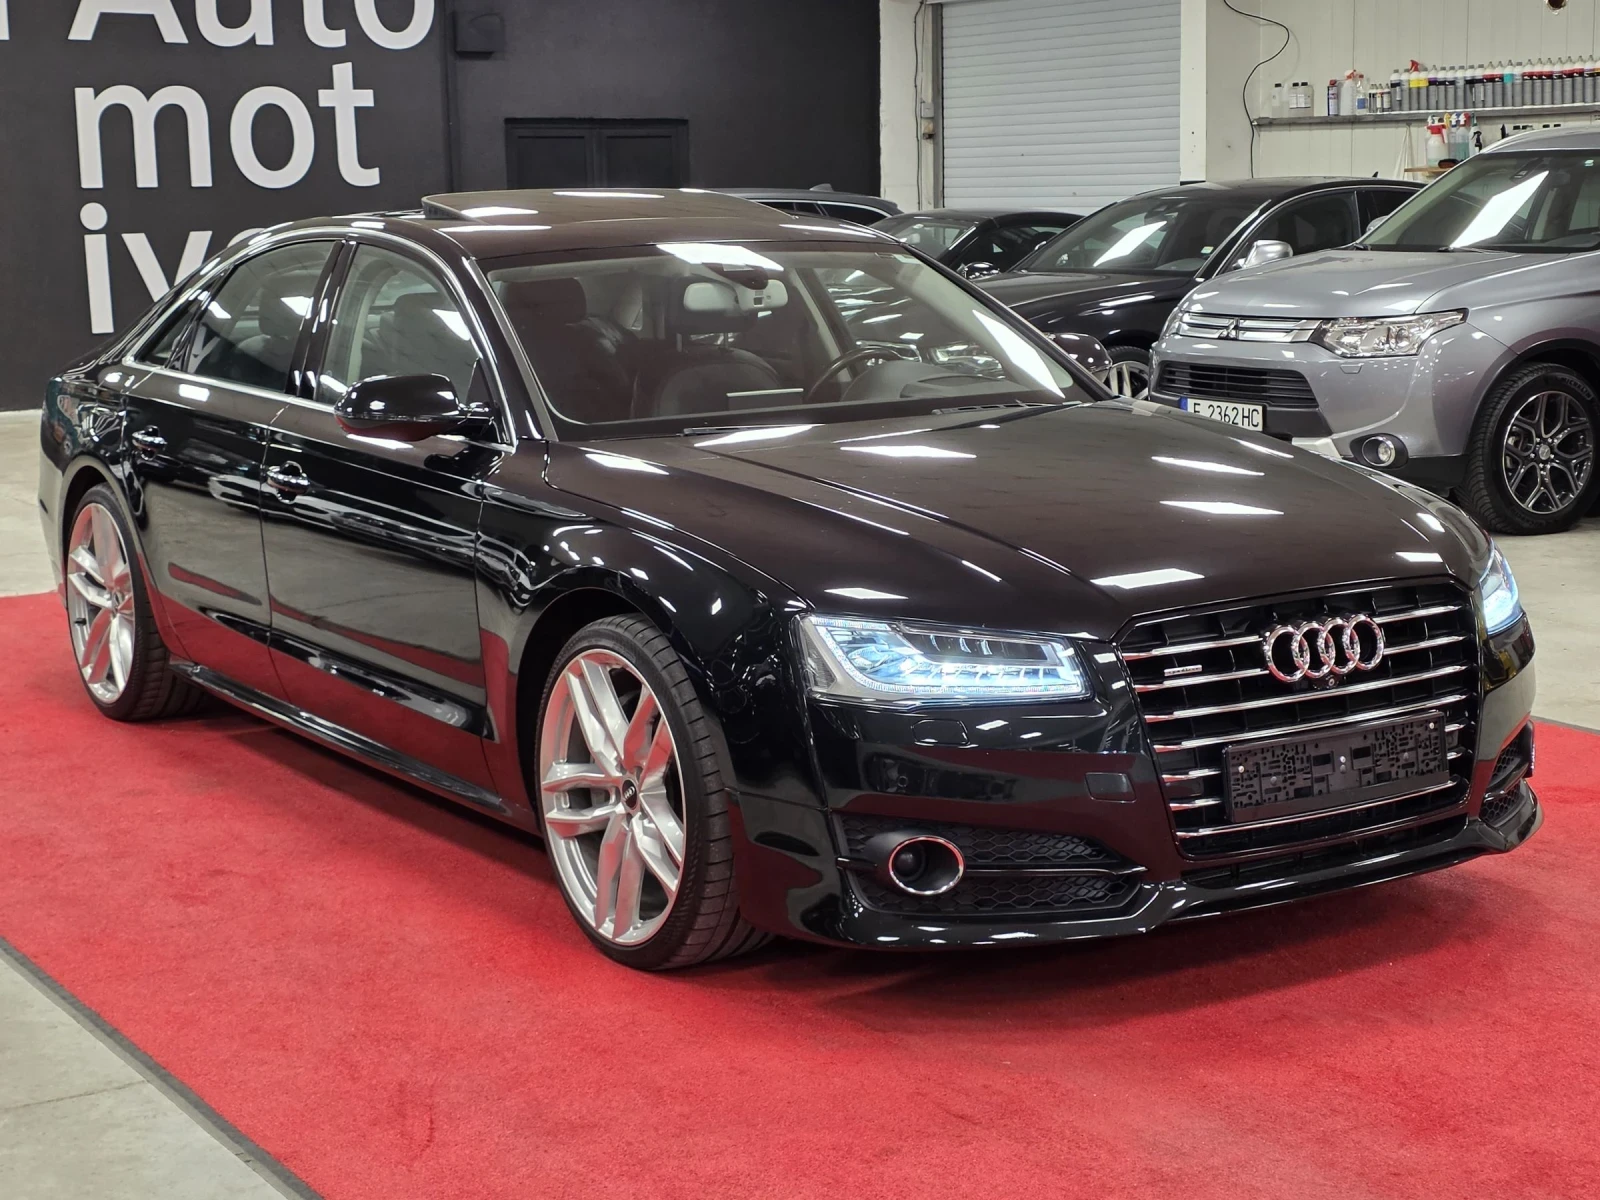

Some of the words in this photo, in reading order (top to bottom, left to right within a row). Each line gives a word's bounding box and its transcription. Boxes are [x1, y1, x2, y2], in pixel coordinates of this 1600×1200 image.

[75, 62, 381, 189] mot
[79, 202, 266, 334] iv
[1241, 407, 1260, 428] HC
